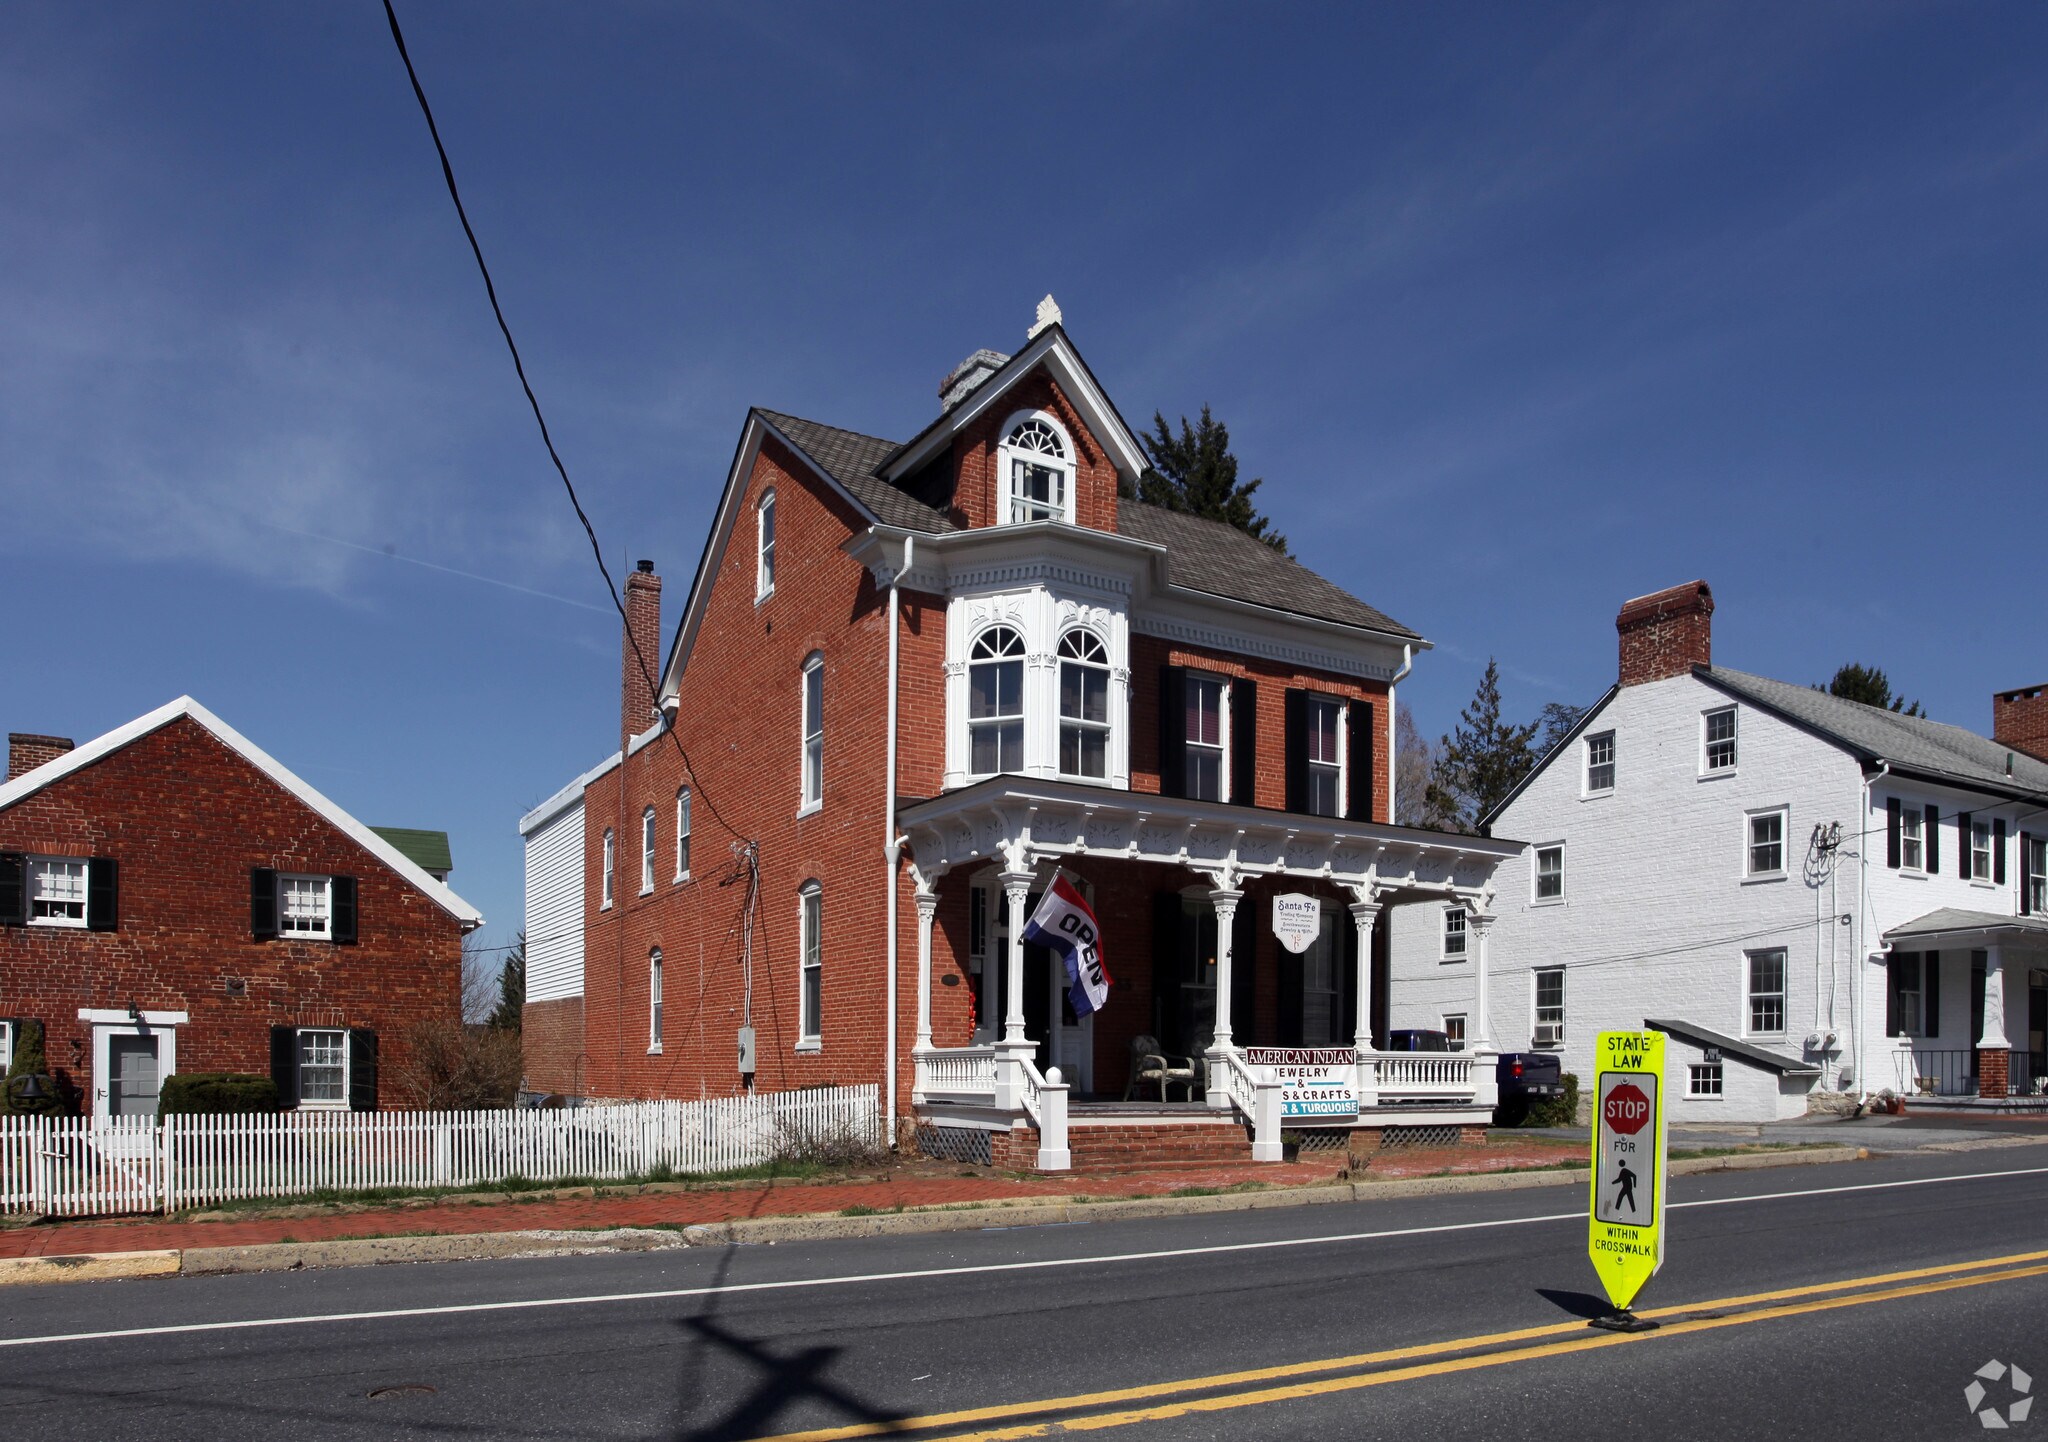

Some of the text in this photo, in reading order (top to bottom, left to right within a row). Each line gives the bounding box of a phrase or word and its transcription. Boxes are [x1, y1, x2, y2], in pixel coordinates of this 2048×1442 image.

[1278, 900, 1316, 913] Santa Fe
[1058, 913, 1103, 986] OPEN
[1608, 1037, 1650, 1051] STATE
[1248, 1050, 1354, 1064] AMERICAN INDIAN
[1613, 1055, 1642, 1068] LAW
[1297, 1078, 1304, 1088] &
[1292, 1090, 1300, 1100] &
[1303, 1089, 1351, 1100] CRAFTS
[1290, 1103, 1299, 1113] &
[1300, 1102, 1357, 1113] TURQUOISE
[1607, 1100, 1647, 1119] STOP
[1613, 1141, 1636, 1153] FOR
[1607, 1227, 1639, 1240] WITHIN
[1595, 1239, 1651, 1256] CROSSWALK
